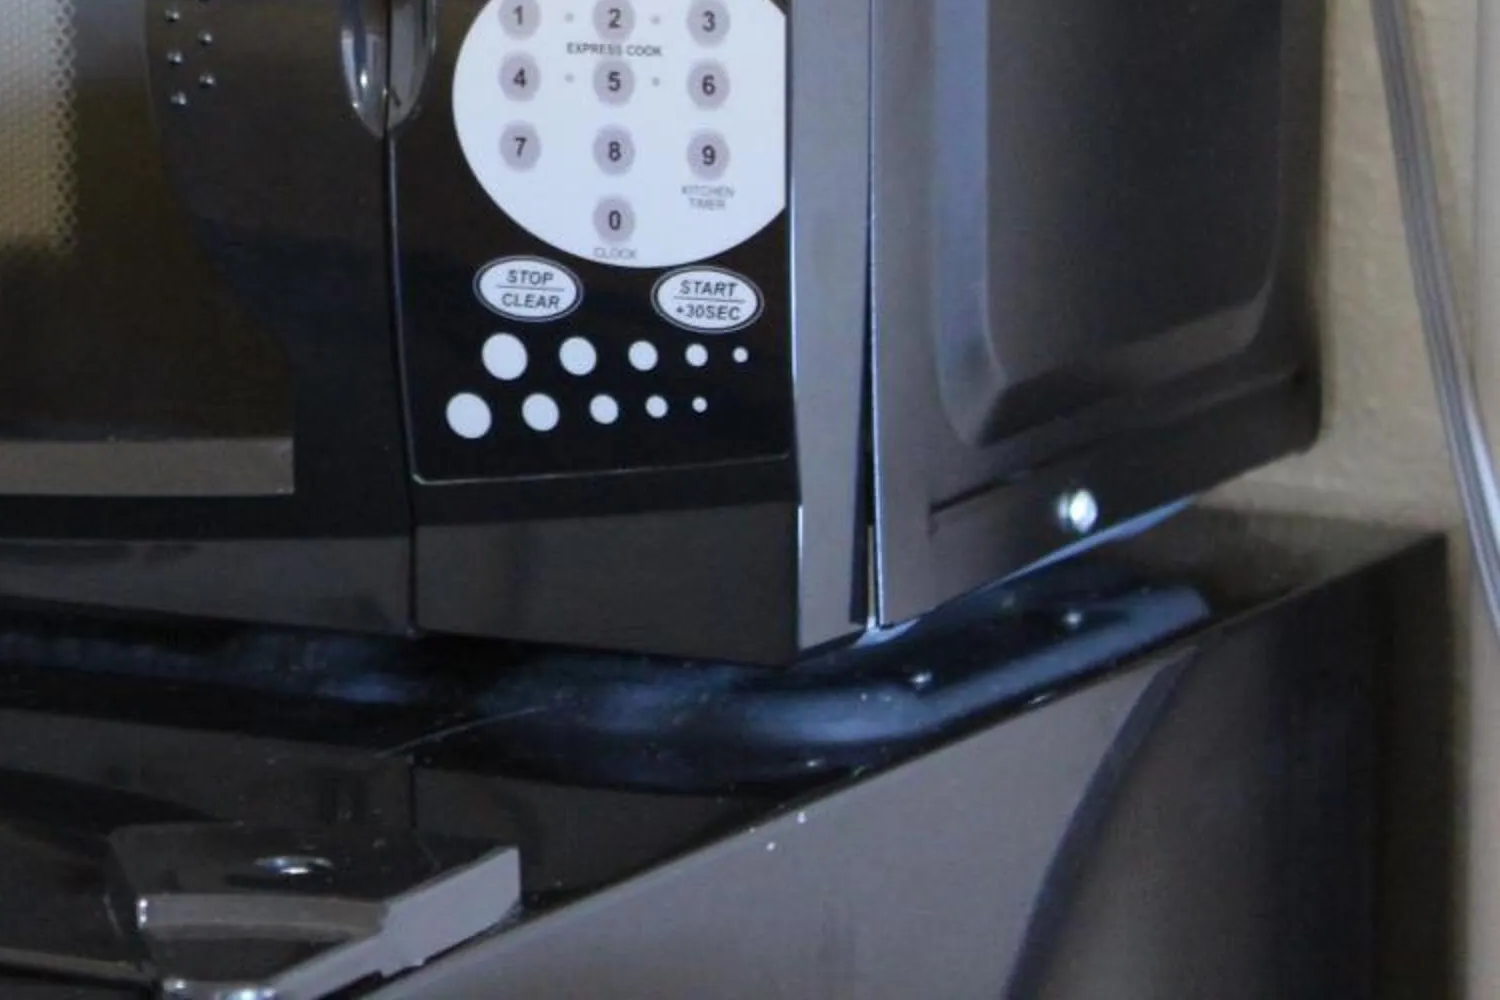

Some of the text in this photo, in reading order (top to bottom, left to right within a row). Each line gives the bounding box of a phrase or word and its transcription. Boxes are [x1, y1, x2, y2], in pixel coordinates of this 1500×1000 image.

[513, 5, 524, 26] 1
[608, 8, 622, 29] 2
[702, 10, 716, 33] 3
[566, 42, 662, 58] EXPRESS COOK
[513, 67, 528, 89] 4
[607, 71, 622, 92] 5
[702, 74, 716, 96] 6
[515, 136, 527, 158] 7
[608, 141, 621, 162] 8
[702, 144, 716, 166] 9
[681, 184, 735, 198] KITCHEN
[608, 209, 622, 231] 0
[593, 246, 637, 260] CLOCK
[506, 269, 554, 286] STOP
[679, 279, 738, 298] START
[501, 291, 561, 310] CLEAR
[675, 303, 741, 321] +30SEC
